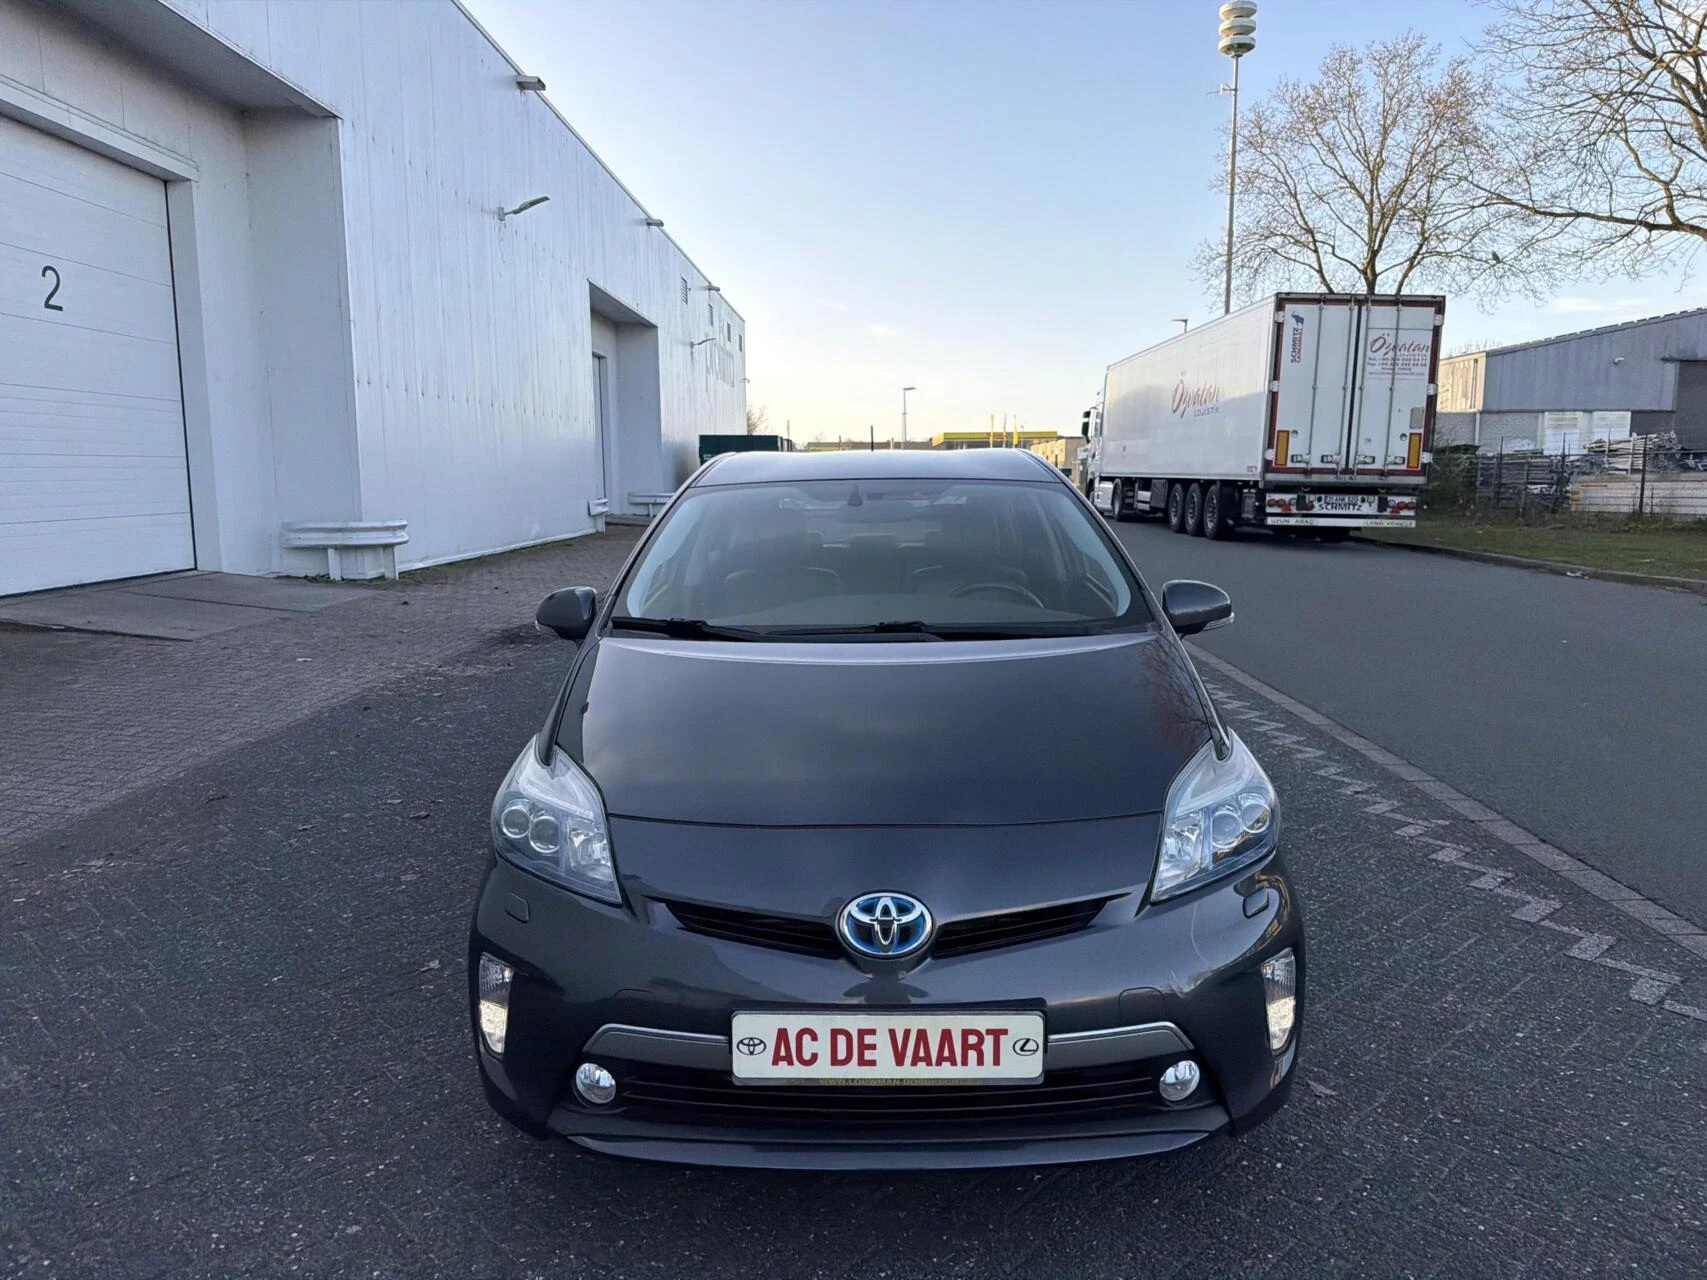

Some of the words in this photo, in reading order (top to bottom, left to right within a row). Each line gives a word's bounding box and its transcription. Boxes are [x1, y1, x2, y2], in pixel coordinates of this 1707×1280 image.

[41, 265, 64, 312] 2
[1318, 502, 1363, 512] SCHMITZ
[771, 1027, 819, 1067] AC
[830, 1028, 878, 1067] DE
[888, 1028, 1009, 1067] VAART
